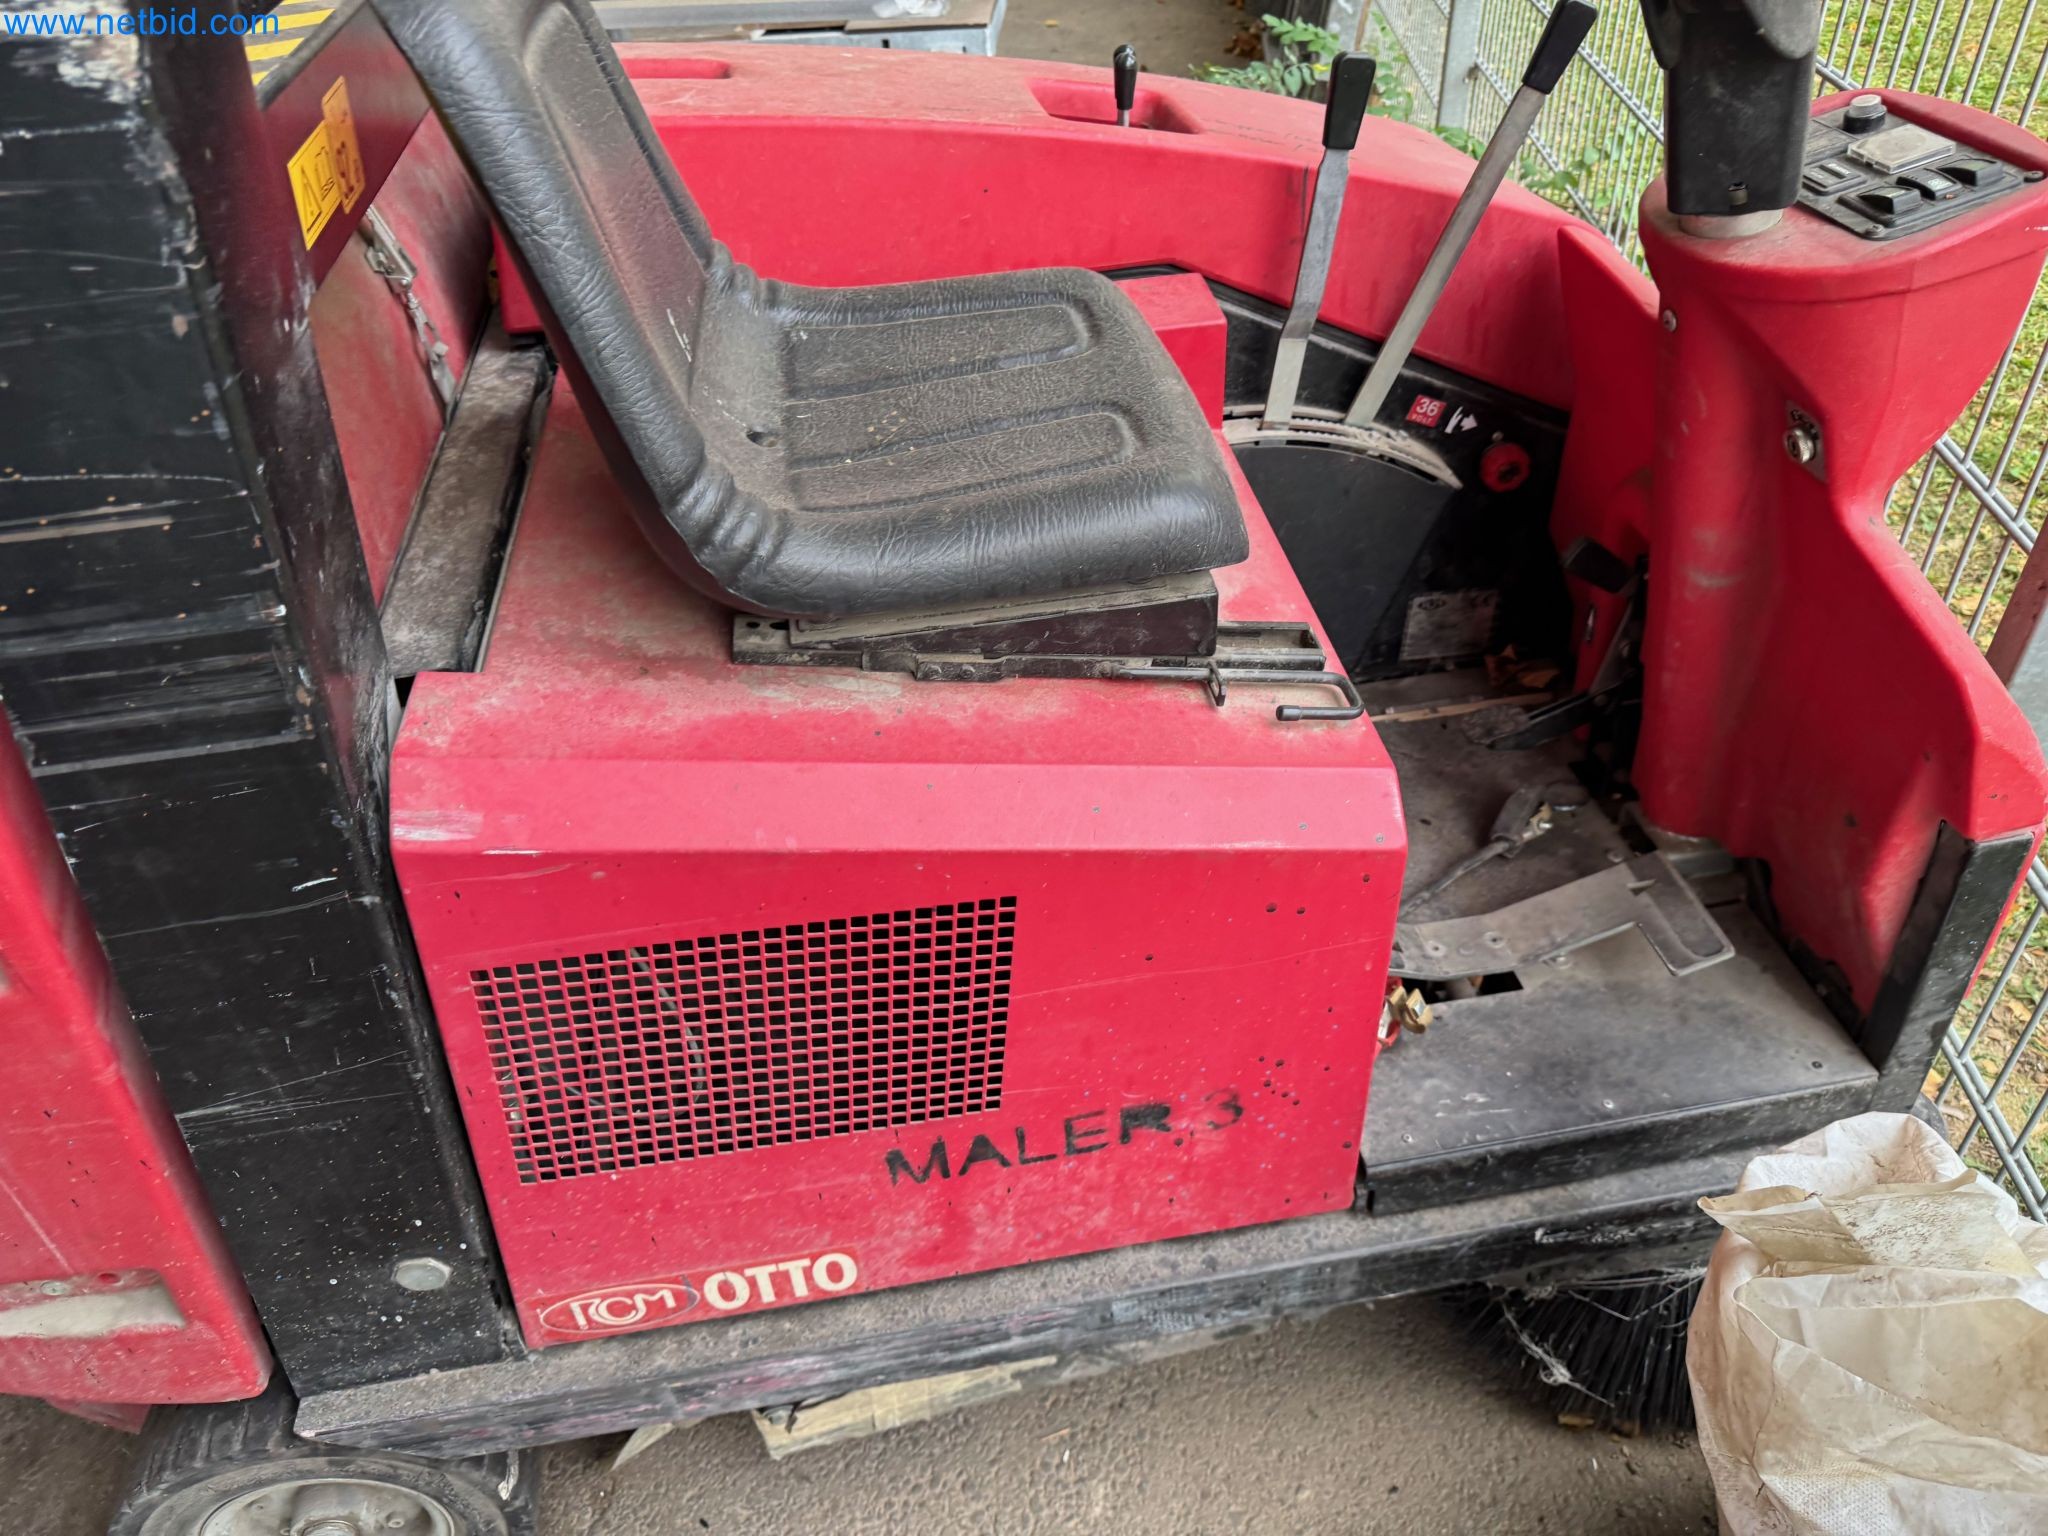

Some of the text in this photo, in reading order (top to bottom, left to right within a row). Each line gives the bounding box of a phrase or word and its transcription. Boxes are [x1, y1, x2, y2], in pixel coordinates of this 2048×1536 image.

[1416, 398, 1440, 416] 36
[569, 1252, 858, 1331] RCM OTTO
